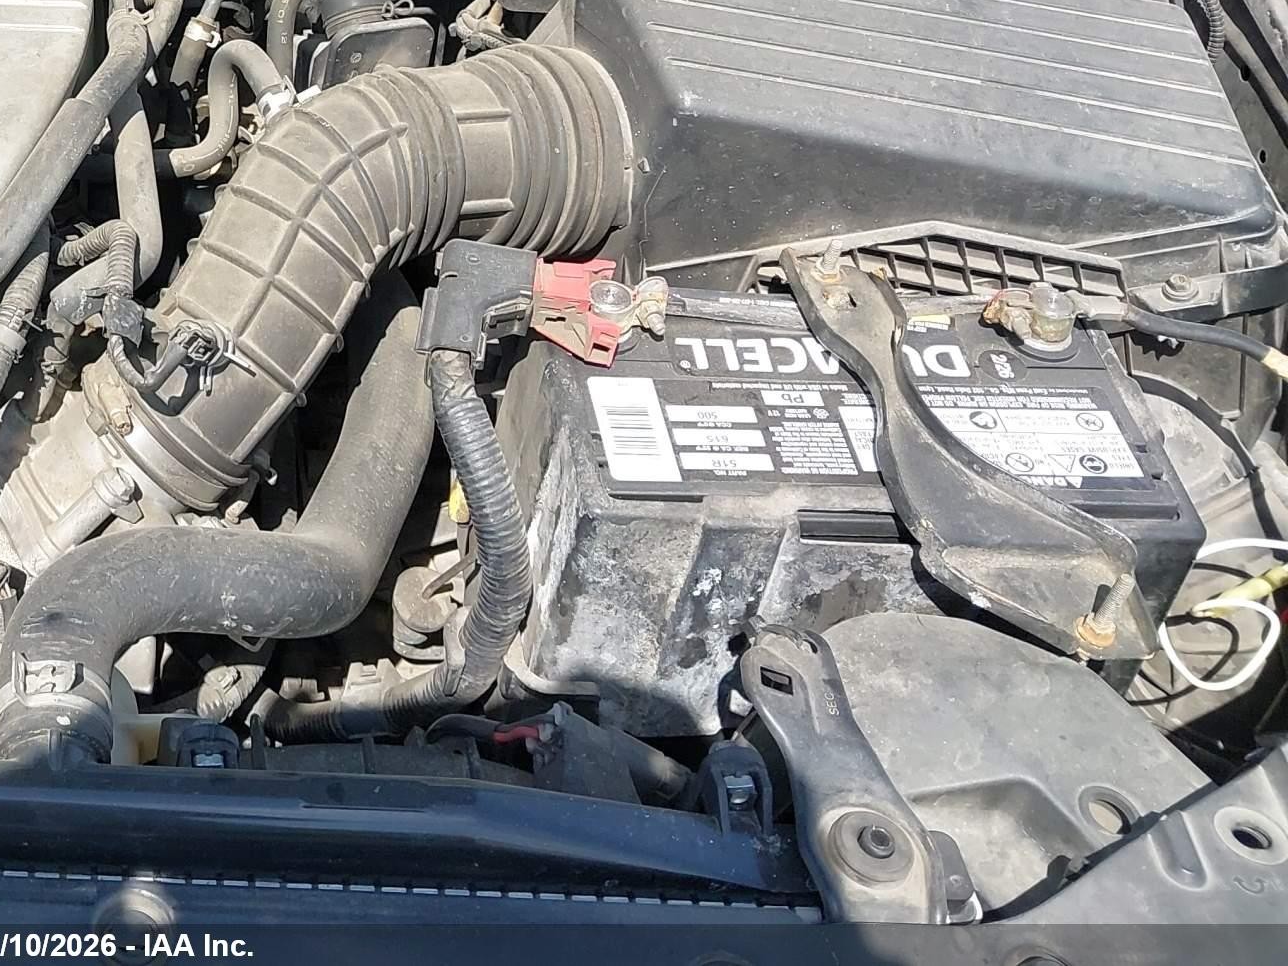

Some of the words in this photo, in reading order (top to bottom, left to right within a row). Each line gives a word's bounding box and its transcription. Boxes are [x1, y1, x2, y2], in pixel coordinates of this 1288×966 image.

[675, 337, 972, 378] DUACELL
[781, 392, 804, 404] Pb
[697, 410, 718, 419] 500
[711, 459, 737, 468] 51R
